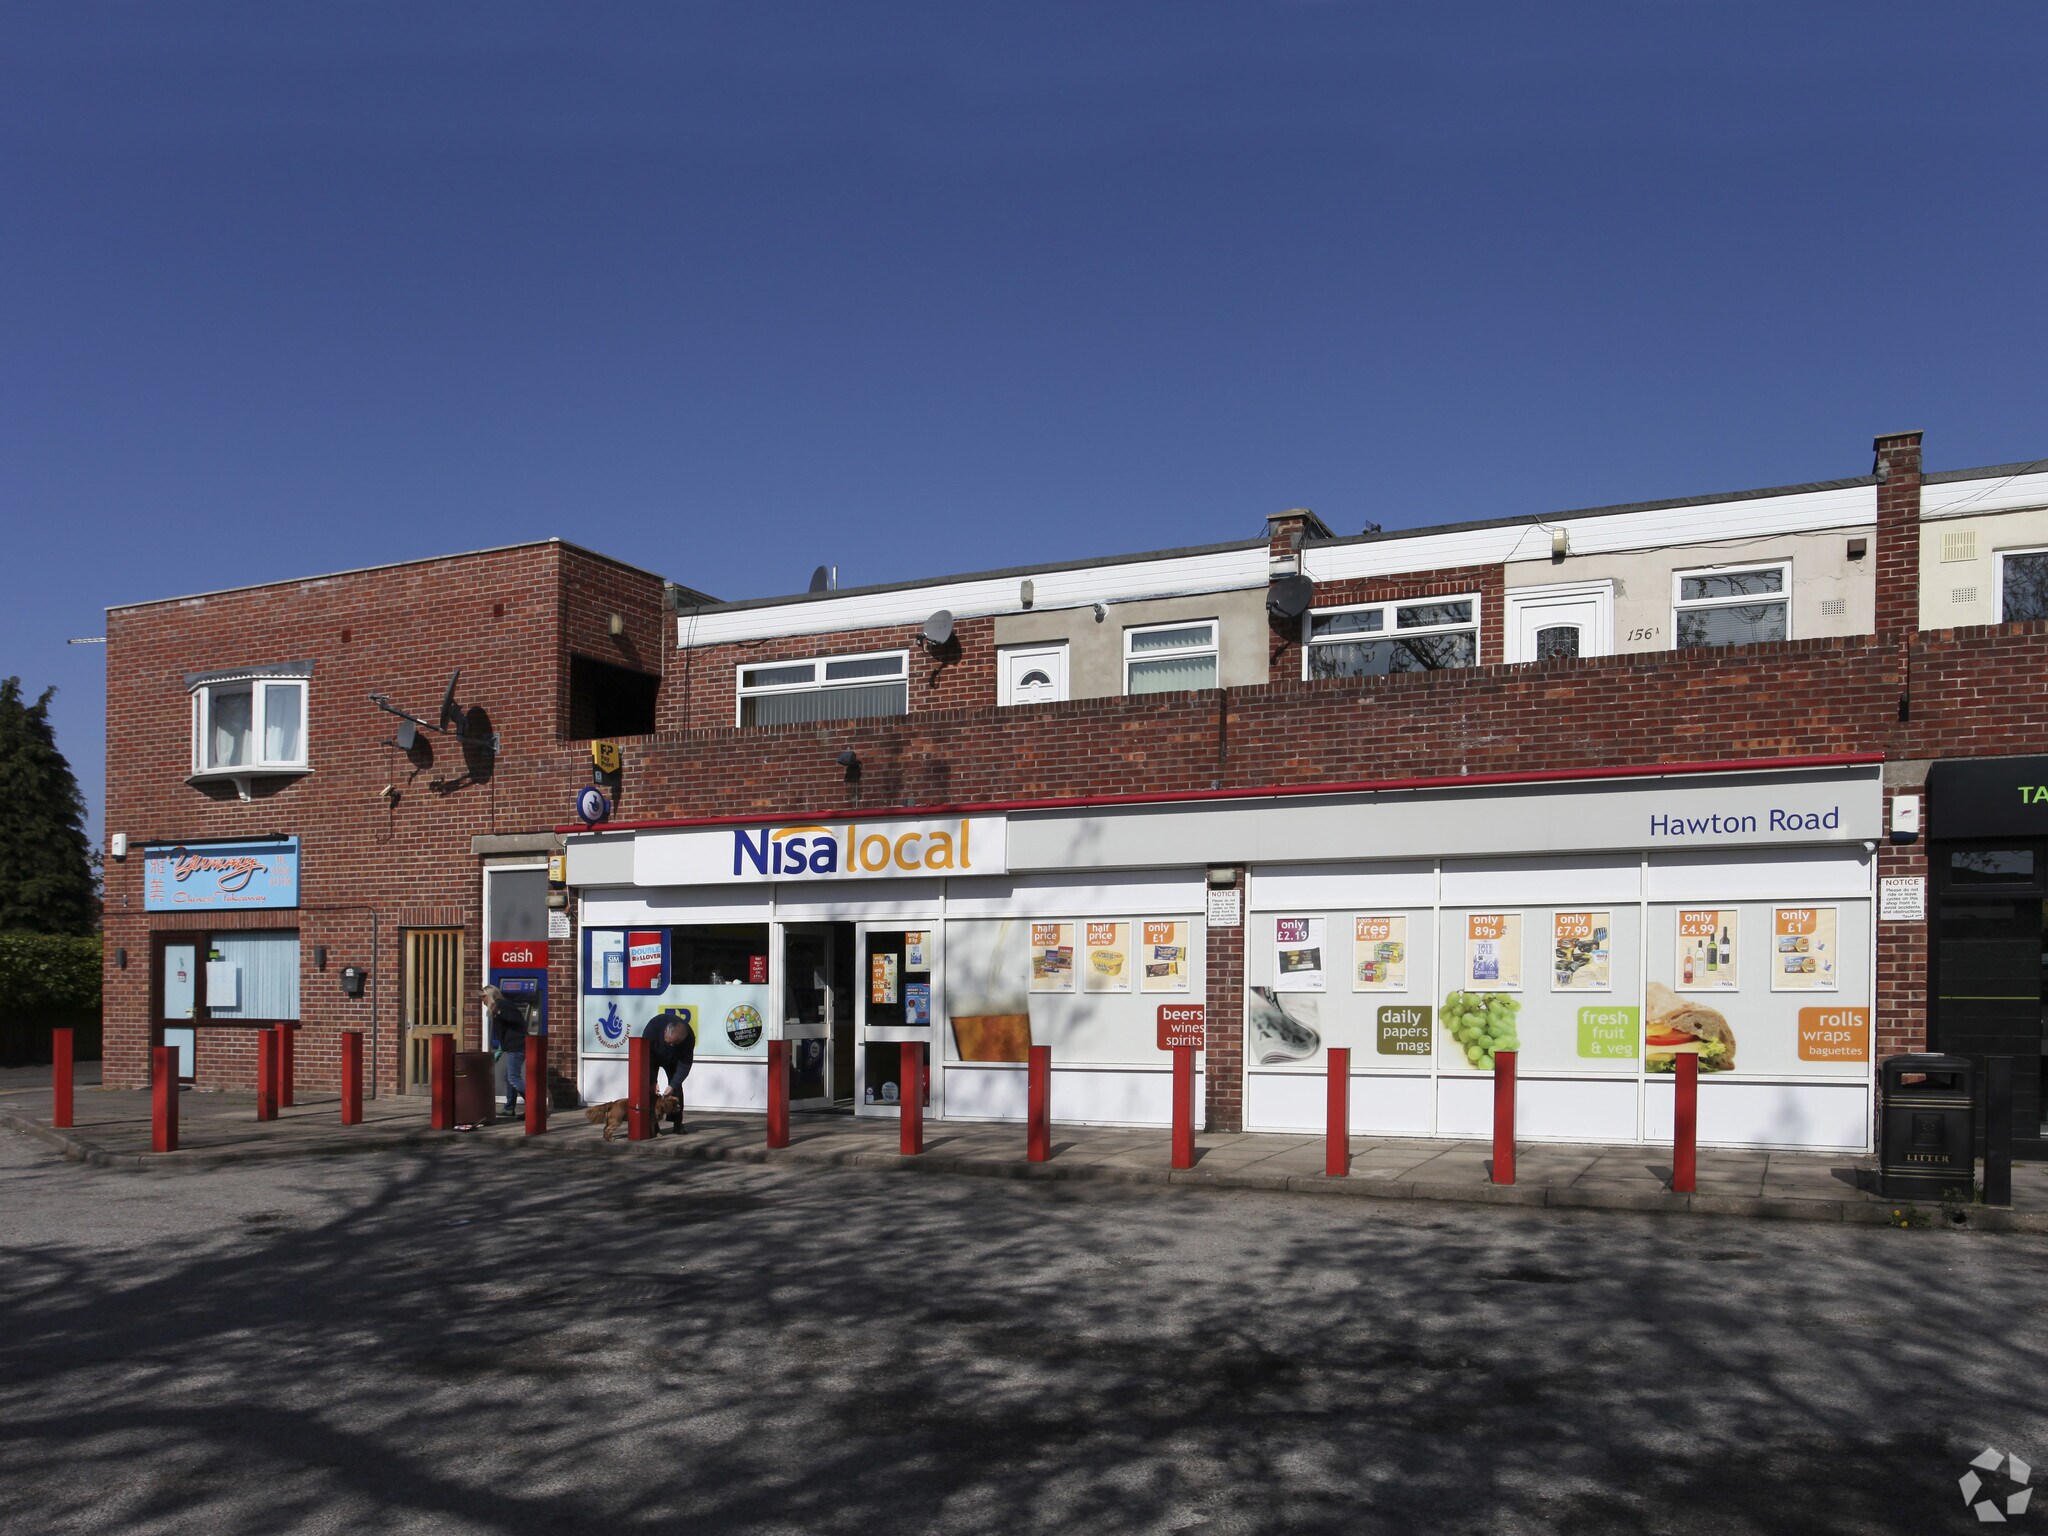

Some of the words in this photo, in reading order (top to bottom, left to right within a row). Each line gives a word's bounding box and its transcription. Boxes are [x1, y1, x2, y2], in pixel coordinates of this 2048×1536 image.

[1650, 812, 1756, 836] Hawton
[1769, 806, 1840, 831] Road
[734, 826, 838, 876] Nisa
[846, 818, 973, 872] local
[167, 845, 268, 891] Yummy
[173, 892, 215, 904] Chinese
[215, 892, 267, 904] Takeaway
[1474, 915, 1498, 926] only
[1560, 914, 1586, 925] only
[1685, 912, 1712, 923] only
[1782, 910, 1810, 922] only
[1092, 924, 1109, 932] half
[1148, 923, 1169, 933] only
[1281, 920, 1304, 930] only
[1358, 924, 1388, 935] free
[1681, 924, 1714, 935] £4.99
[1788, 923, 1802, 933] £1
[1277, 931, 1307, 940] £2.19
[1474, 927, 1496, 938] 89p
[1557, 926, 1588, 936] £7.99
[1034, 932, 1056, 942] price
[1090, 932, 1112, 942] price
[1153, 934, 1164, 943] £1
[502, 949, 533, 962] cash
[631, 946, 661, 955] DOUBLE
[1163, 1008, 1203, 1020] beers
[1381, 1010, 1422, 1026] daily
[1582, 1010, 1628, 1025] fresh
[1819, 1012, 1863, 1026] rolls
[1171, 1022, 1204, 1033] wines
[1383, 1026, 1428, 1039] papers
[1593, 1026, 1625, 1039] fruit
[597, 1035, 620, 1049] National
[619, 1024, 632, 1046] Lottery
[1166, 1035, 1202, 1048] spirits
[1803, 1029, 1851, 1044] wraps
[1396, 1041, 1430, 1054] mags
[1591, 1042, 1602, 1054] &
[1607, 1044, 1633, 1058] veg
[1809, 1045, 1862, 1058] baguettes
[1907, 1154, 1949, 1162] LITTER
